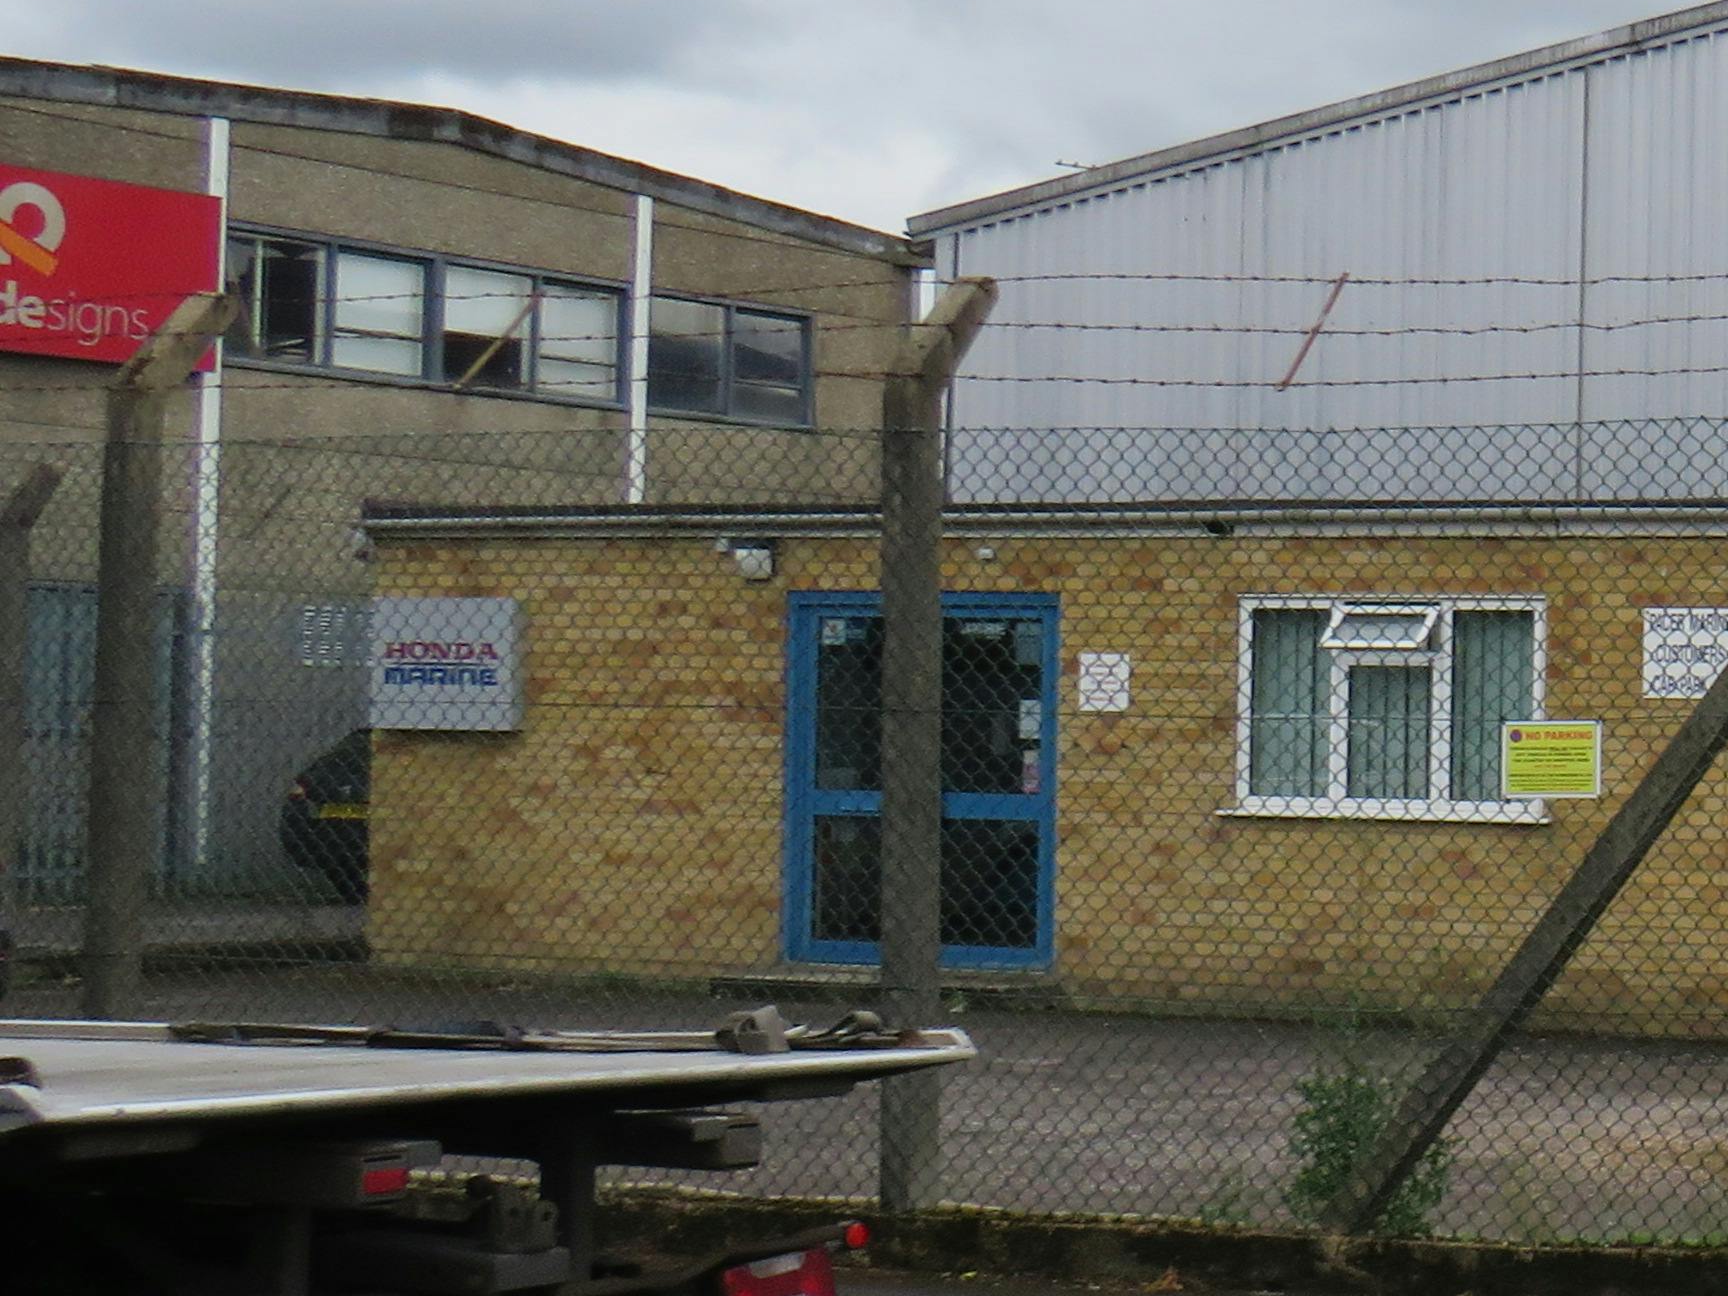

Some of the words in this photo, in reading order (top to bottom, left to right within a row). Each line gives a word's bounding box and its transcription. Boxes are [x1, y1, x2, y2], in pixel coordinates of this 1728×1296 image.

[384, 641, 498, 660] HONDA
[384, 667, 499, 686] MARINE
[1525, 730, 1541, 740] NO
[1544, 730, 1593, 740] PARKING
